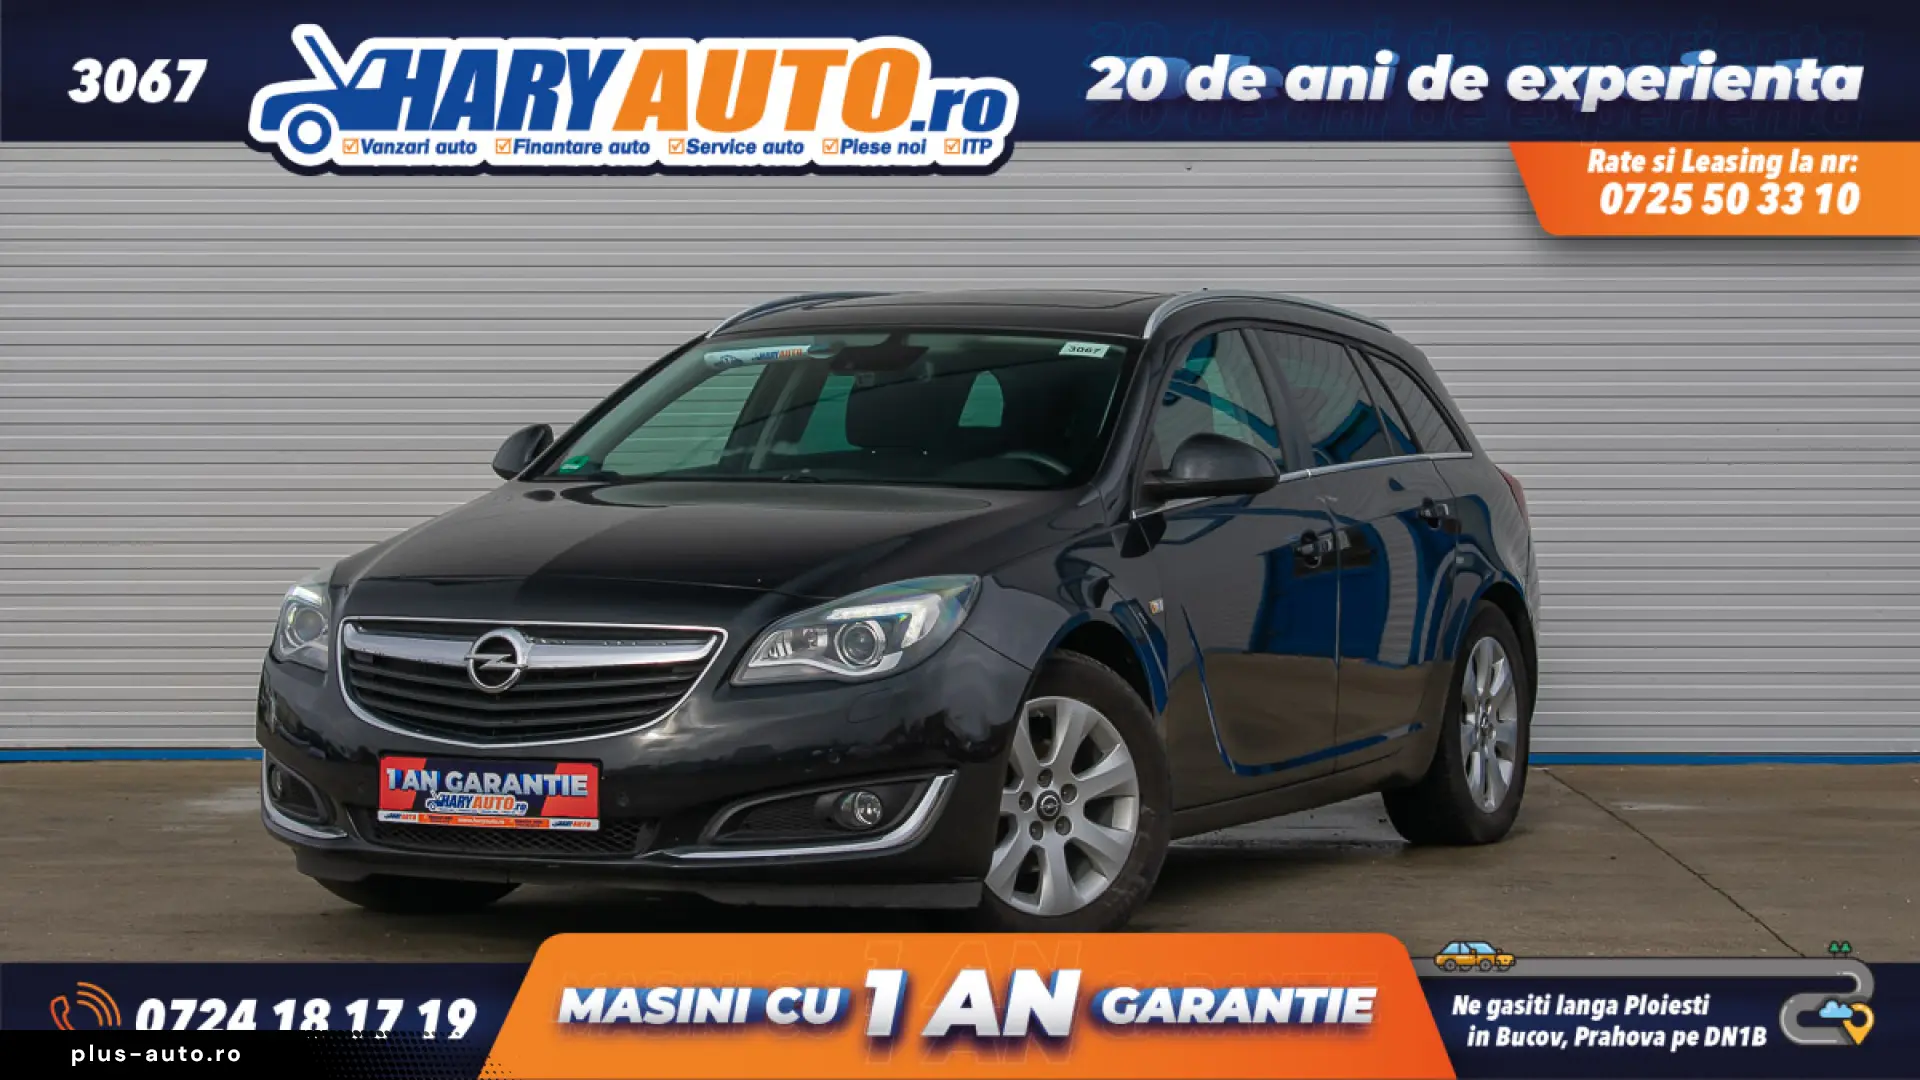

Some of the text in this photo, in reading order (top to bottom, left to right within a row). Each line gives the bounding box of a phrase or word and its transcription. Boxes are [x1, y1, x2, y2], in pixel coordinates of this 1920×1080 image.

[386, 768, 588, 796] 1 AN GARANTIE
